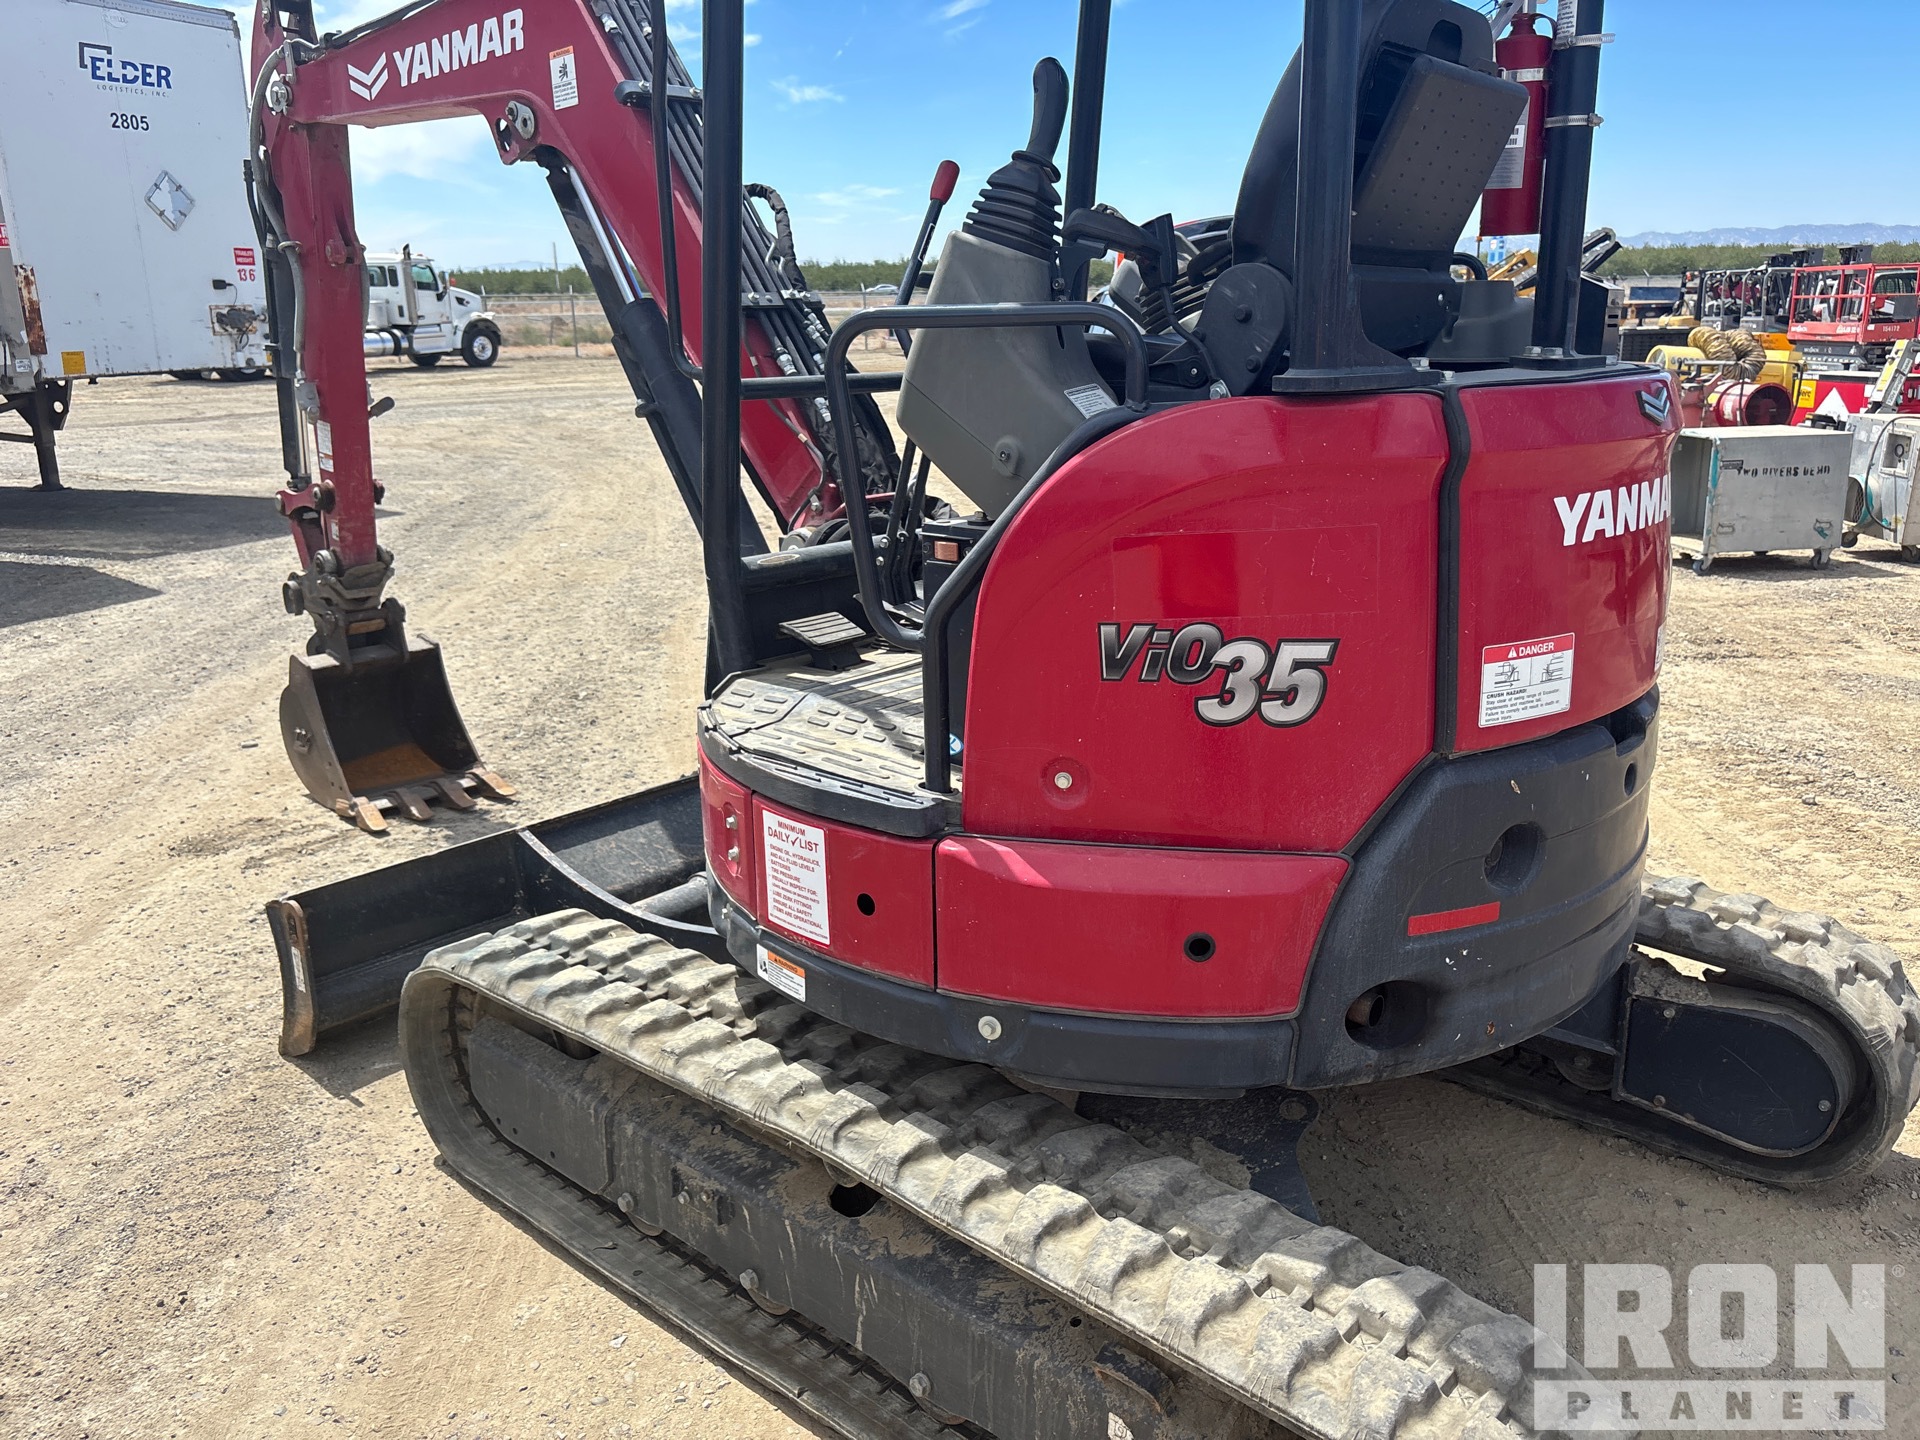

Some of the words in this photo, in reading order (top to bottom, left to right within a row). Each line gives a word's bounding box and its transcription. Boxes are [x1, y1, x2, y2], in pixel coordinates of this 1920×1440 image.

[393, 8, 524, 88] YANMAR
[88, 56, 172, 90] ELDER
[96, 84, 147, 96] LOGISTICS,
[109, 112, 150, 132] 2805
[1762, 466, 1799, 477] RIVERS
[1553, 472, 1671, 547] YANMA
[1519, 642, 1554, 657] DANGER
[778, 820, 805, 836] MINIMUM
[768, 826, 790, 843] DAILY
[800, 838, 819, 853] LIST
[771, 859, 791, 871] BATTERIES
[799, 862, 815, 872] LEVELS
[790, 882, 806, 892] INSPECT
[794, 899, 812, 910] FITTINGS
[796, 907, 813, 918] SAFETY
